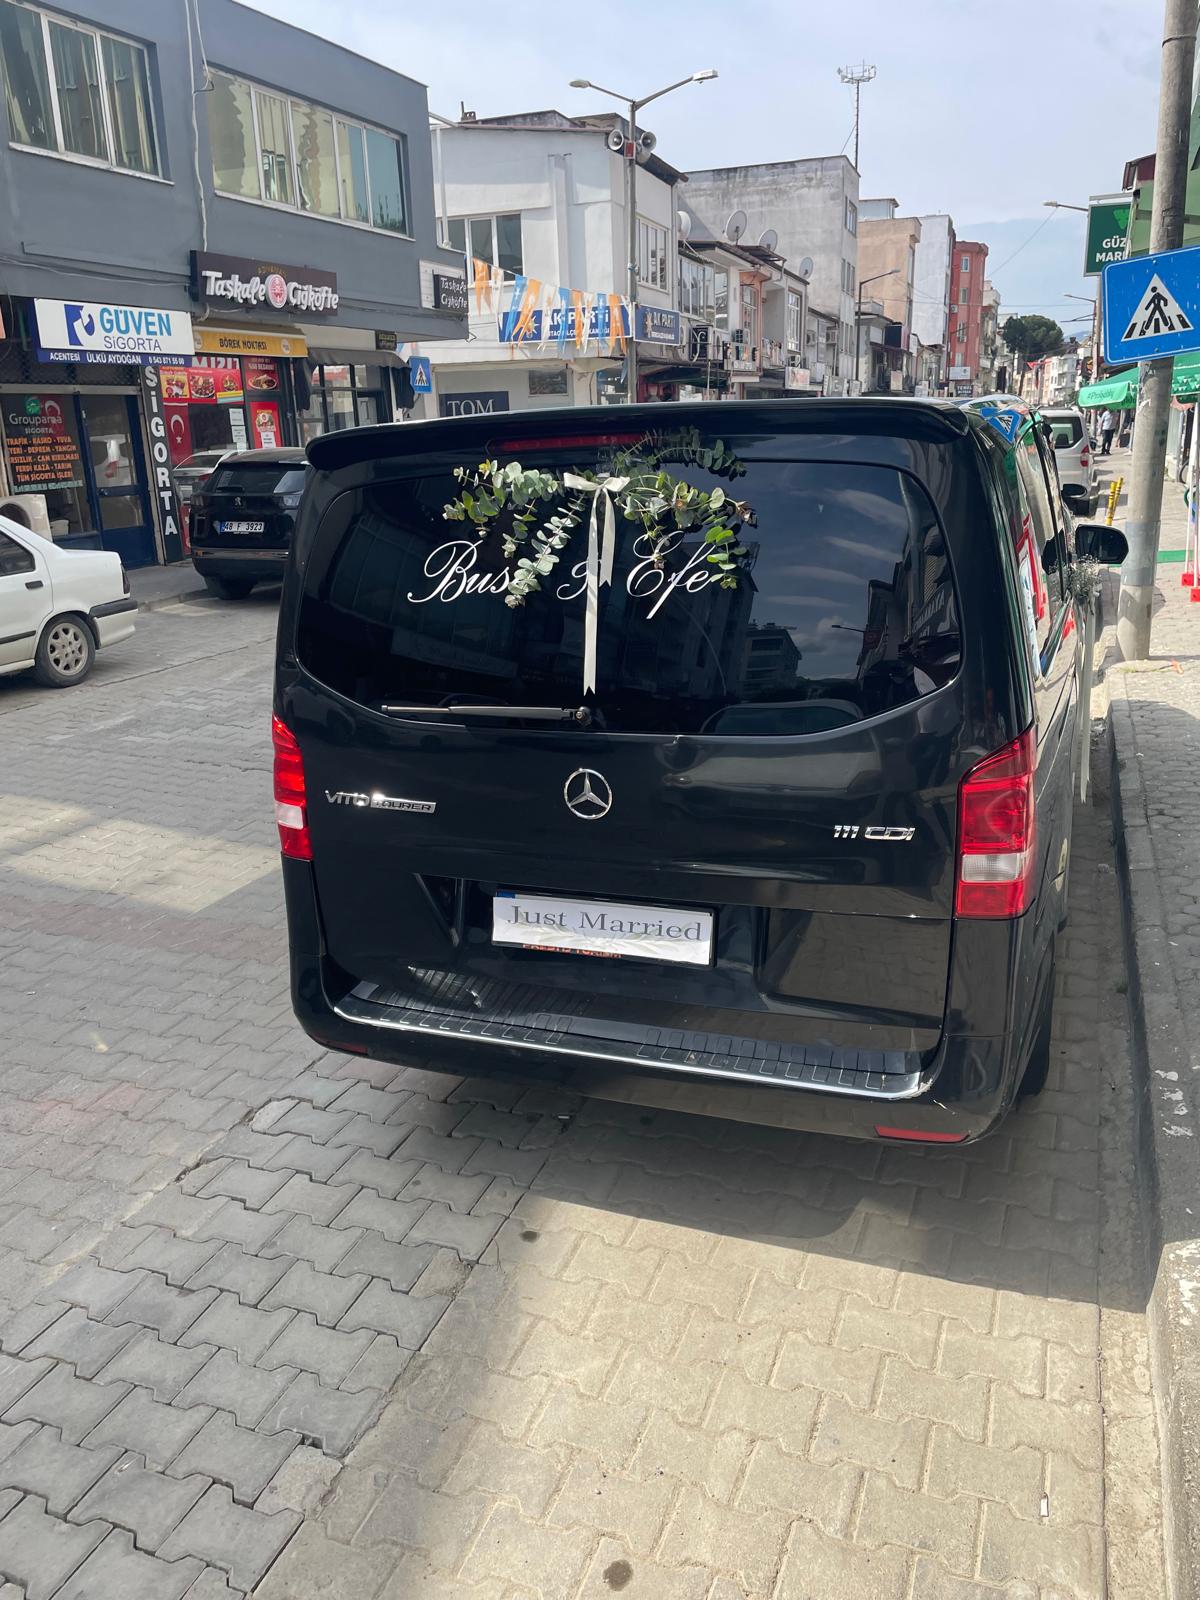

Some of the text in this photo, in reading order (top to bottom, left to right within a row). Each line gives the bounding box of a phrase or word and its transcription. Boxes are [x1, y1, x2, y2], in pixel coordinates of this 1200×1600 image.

[1102, 235, 1127, 249] GÜZ
[202, 270, 266, 305] Taşkale
[99, 307, 172, 337] GÜVEN
[219, 337, 241, 349] BÖREK
[50, 352, 80, 361] ACENTESİ
[86, 352, 107, 363] ÜLKÜ
[108, 354, 142, 364] AYDOĞAN
[447, 399, 495, 415] TOM
[245, 522, 263, 531] 3923
[626, 530, 717, 619] Efe
[371, 796, 434, 812] OURER
[834, 825, 916, 840] 111 CDI
[507, 905, 702, 941] Just Married
